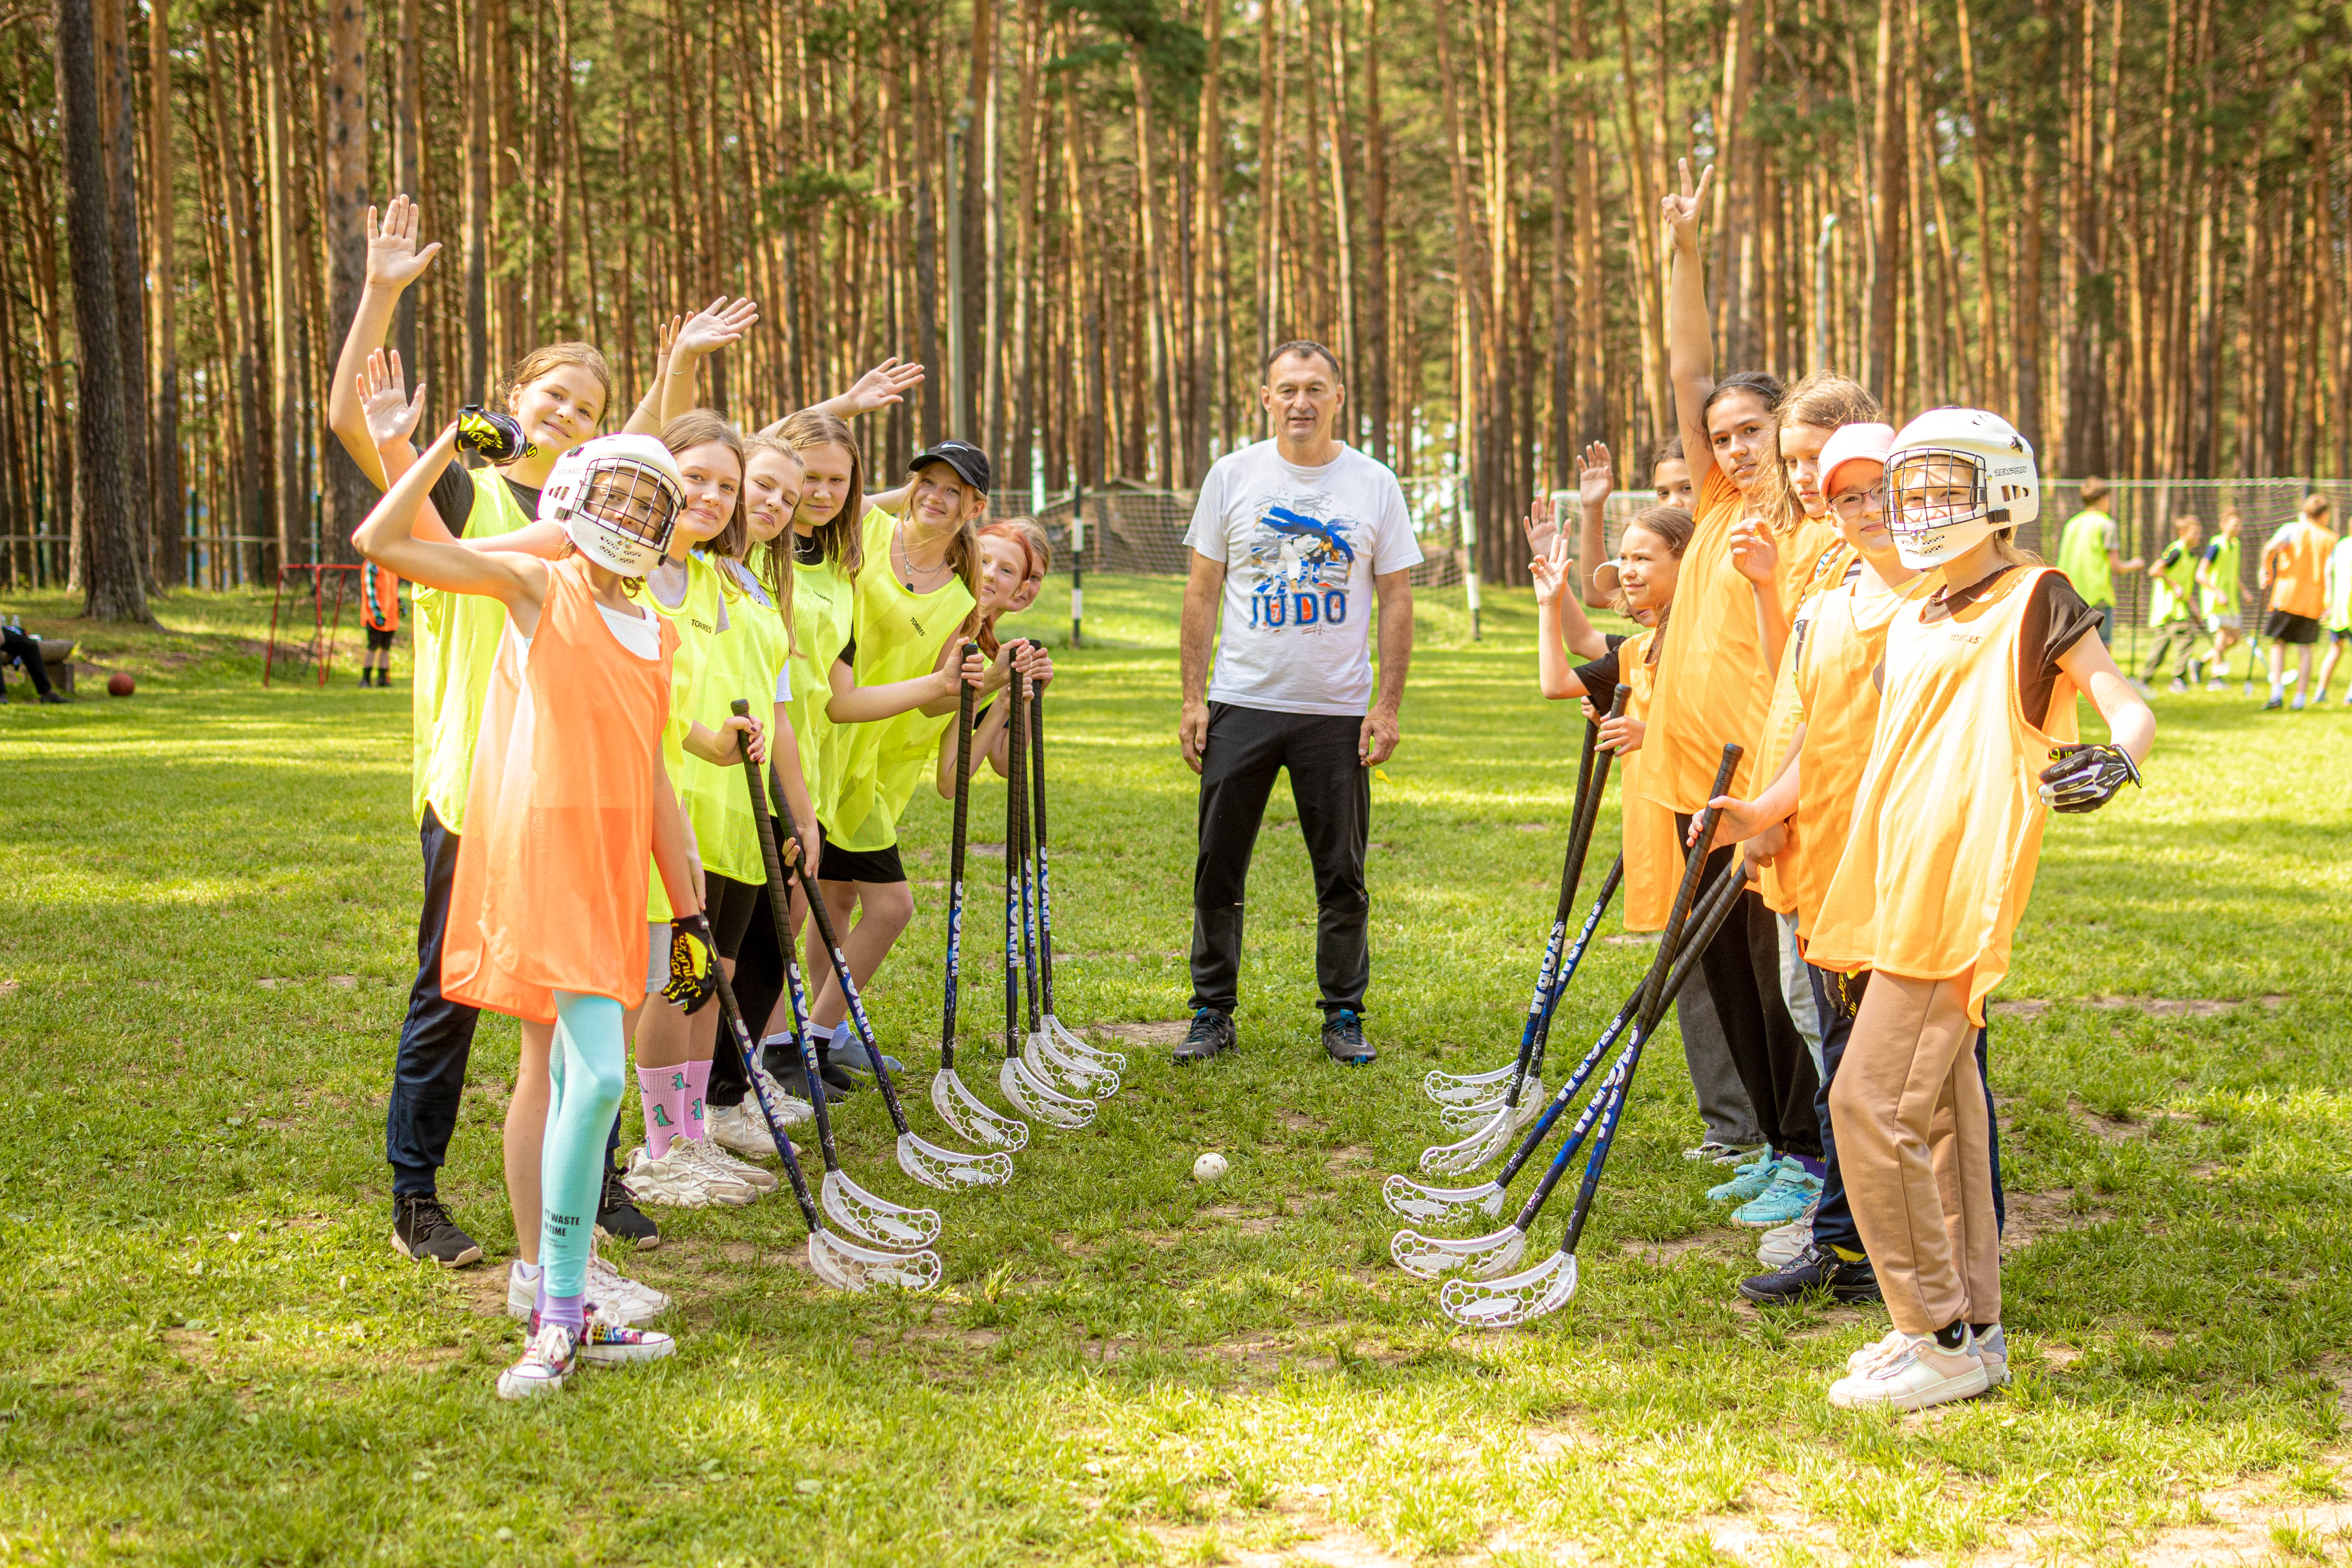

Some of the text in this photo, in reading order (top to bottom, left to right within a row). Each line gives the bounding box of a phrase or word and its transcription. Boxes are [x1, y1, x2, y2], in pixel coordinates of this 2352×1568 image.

[1994, 466, 2027, 477] TEMPISH
[1249, 590, 1347, 629] JUDO
[692, 619, 712, 634] TORRES
[911, 617, 925, 637] TORRES
[1530, 921, 1565, 1014] STORM
[551, 1212, 580, 1225] WASTE
[549, 1224, 566, 1237] TIME
